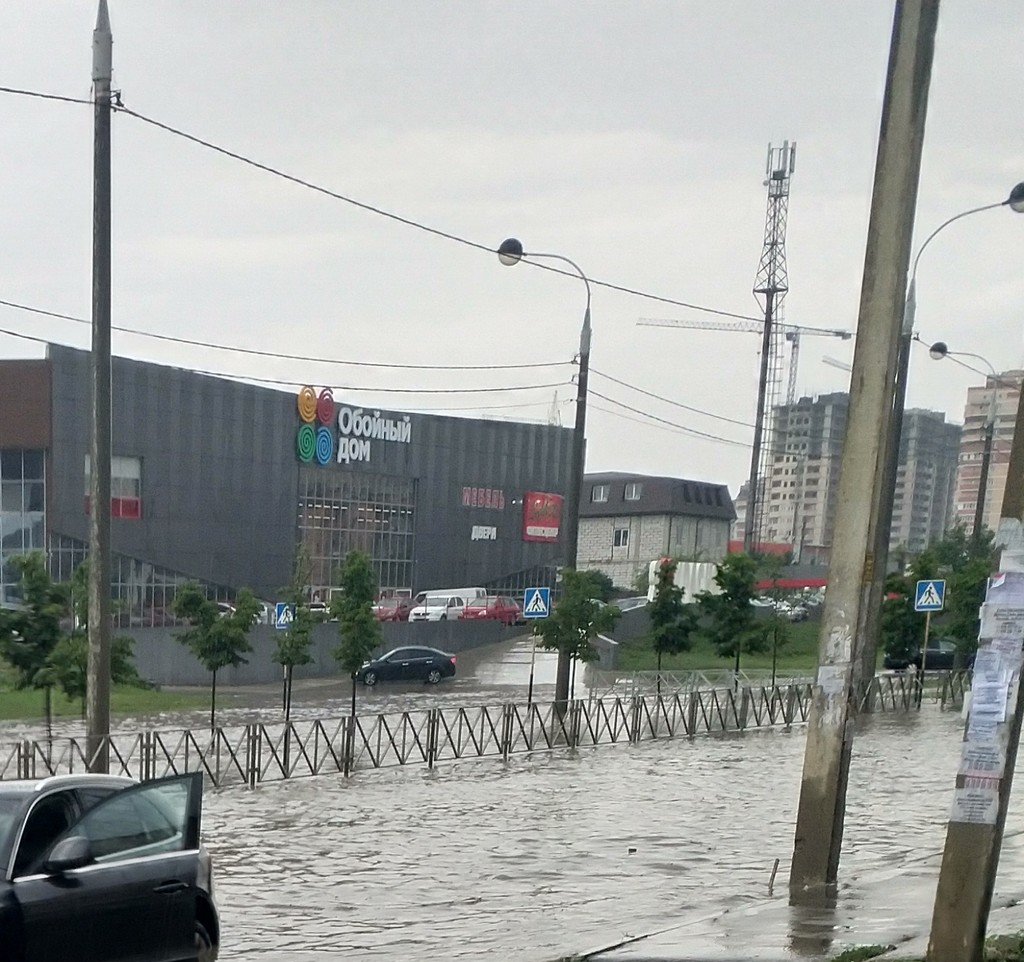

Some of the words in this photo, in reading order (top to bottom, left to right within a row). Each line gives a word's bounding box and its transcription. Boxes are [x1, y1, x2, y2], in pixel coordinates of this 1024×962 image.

[338, 407, 411, 443] Обойный
[462, 486, 505, 510] МЕБЕЛЬ
[471, 525, 497, 541] ДВЕРИ
